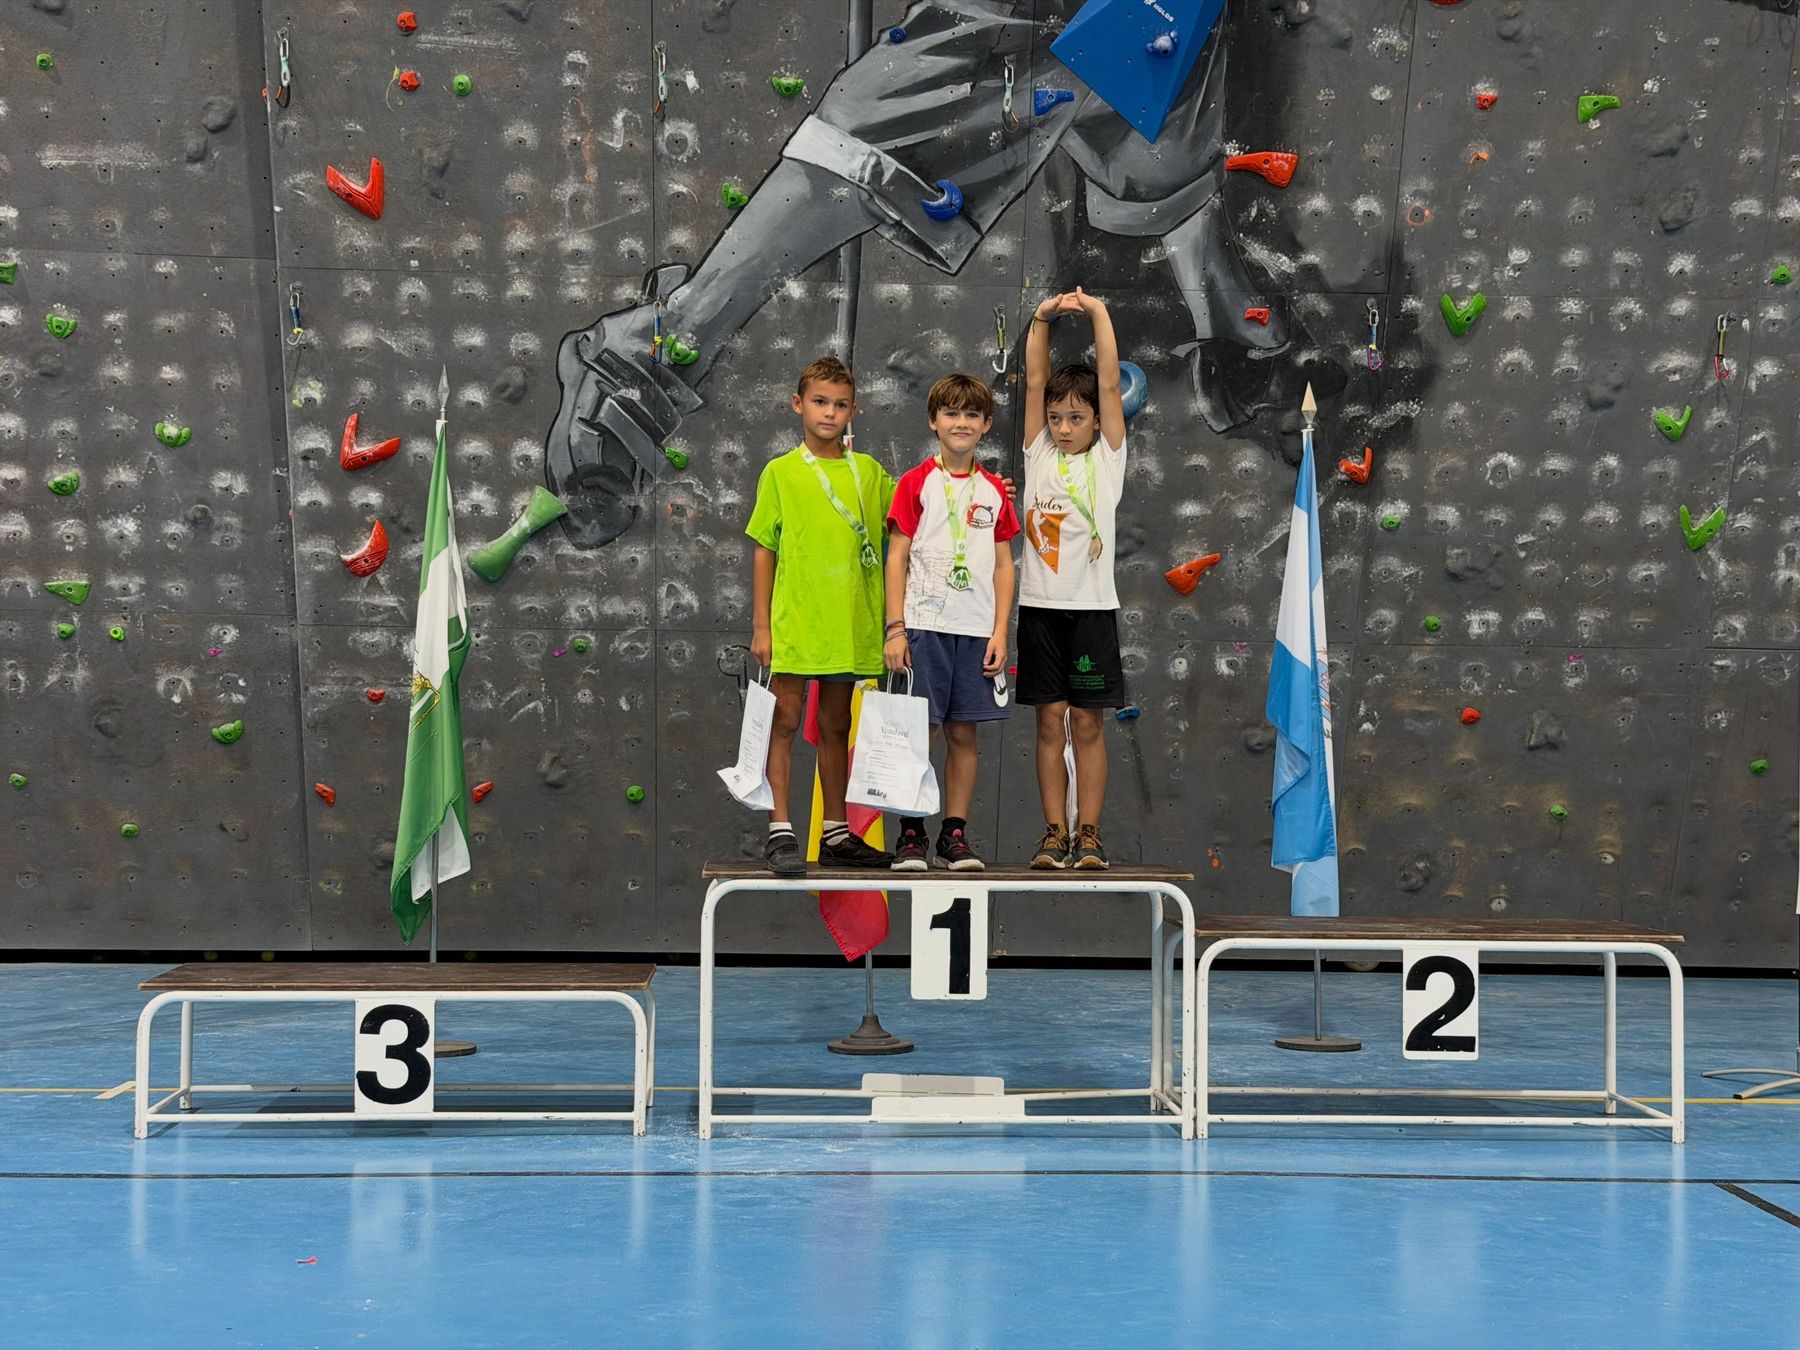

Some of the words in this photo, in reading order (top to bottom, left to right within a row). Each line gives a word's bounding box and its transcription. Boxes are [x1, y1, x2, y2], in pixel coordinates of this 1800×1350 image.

[1153, 3, 1175, 23] HOLDS
[930, 898, 971, 994] 1
[1406, 956, 1476, 1052] 2
[356, 1004, 431, 1105] 3
